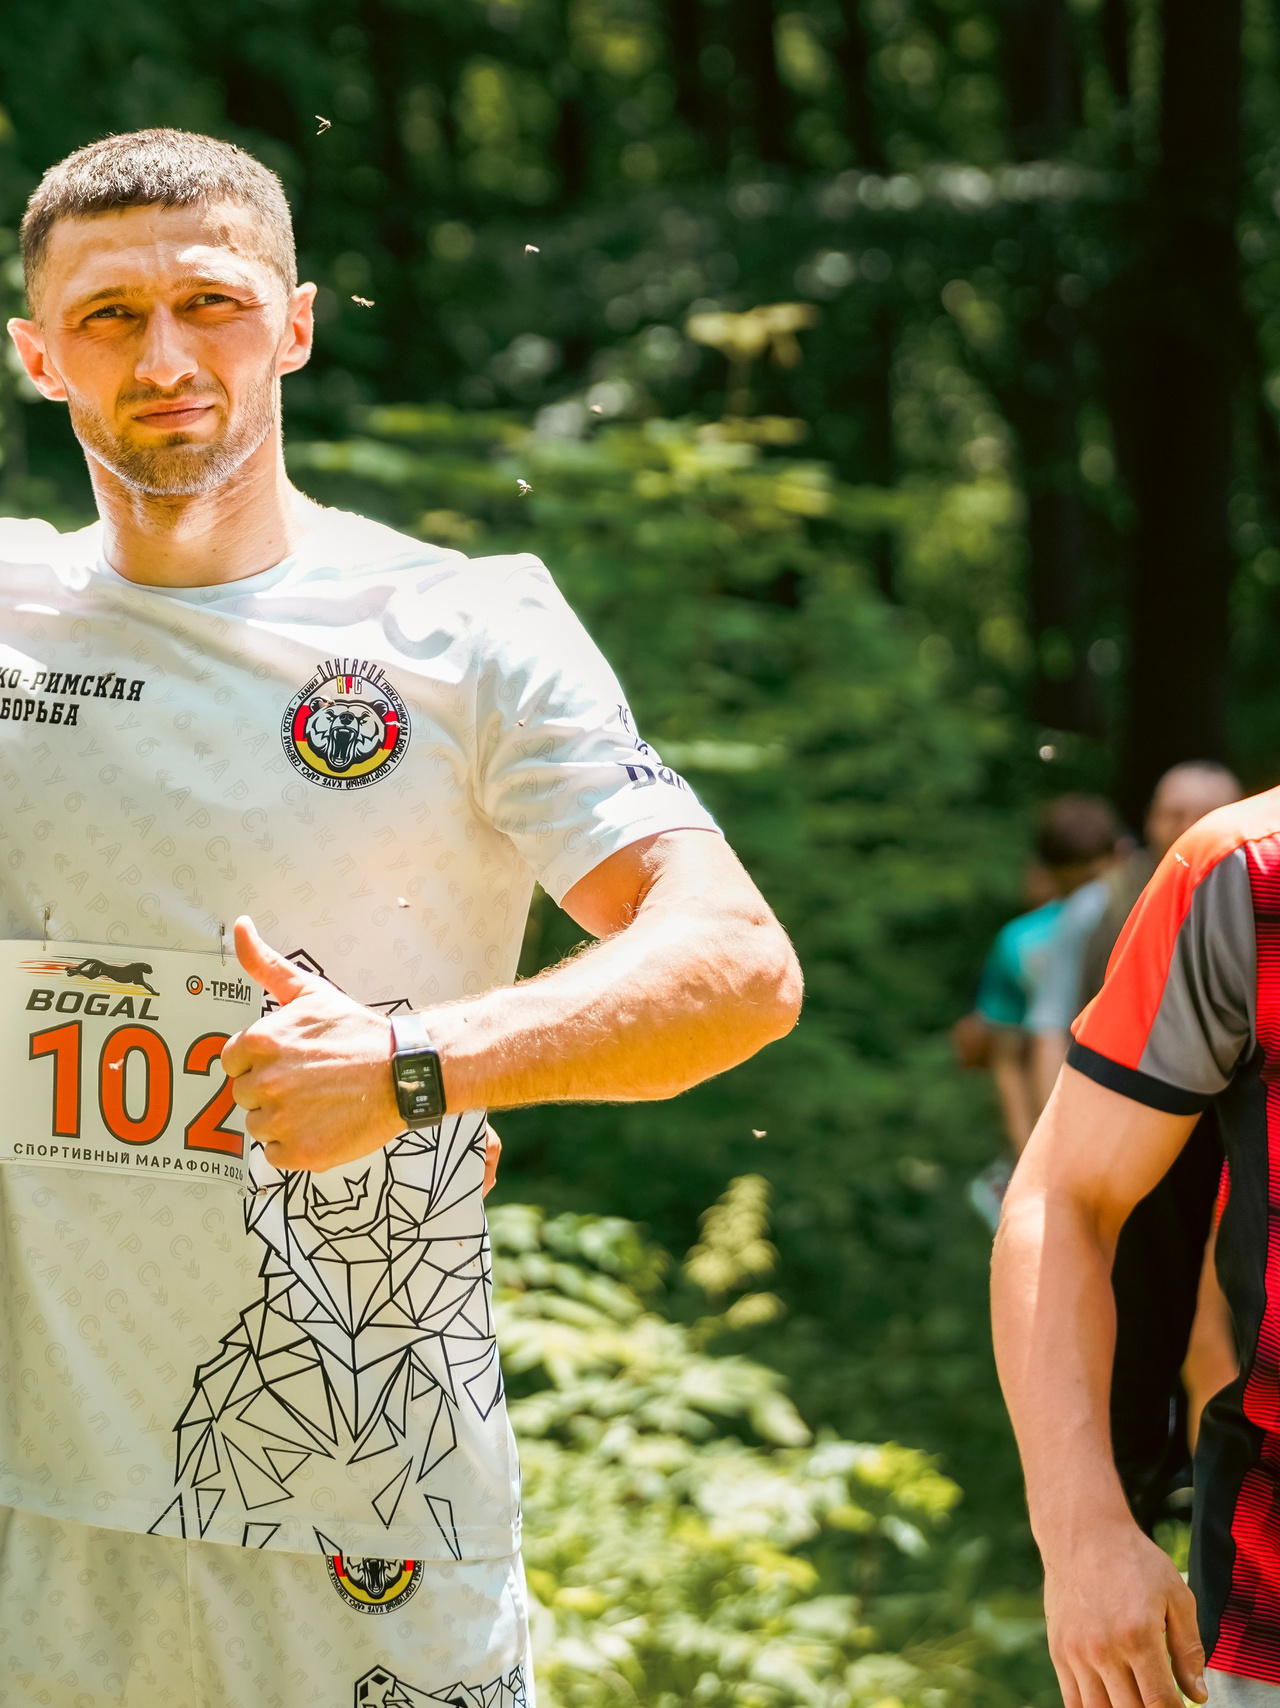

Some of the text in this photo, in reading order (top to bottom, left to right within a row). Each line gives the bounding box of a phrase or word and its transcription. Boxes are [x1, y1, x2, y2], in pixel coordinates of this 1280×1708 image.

[316, 658, 386, 684] ДОНГАРОН
[297, 679, 320, 701] АЛАНИЯ
[336, 676, 363, 694] АРС
[282, 707, 295, 733] ОСЕТИЯ
[283, 735, 302, 767] СЕВЕРНАЯ
[389, 738, 406, 764] БОРЬБА
[321, 777, 343, 789] КЛУБ
[345, 763, 391, 790] СПОРТИВНЫЙ
[25, 989, 160, 1021] BOGAL
[29, 1019, 245, 1160] 102
[13, 1143, 243, 1181] СПОРТИВНЫЙ МАРАФОН 2026
